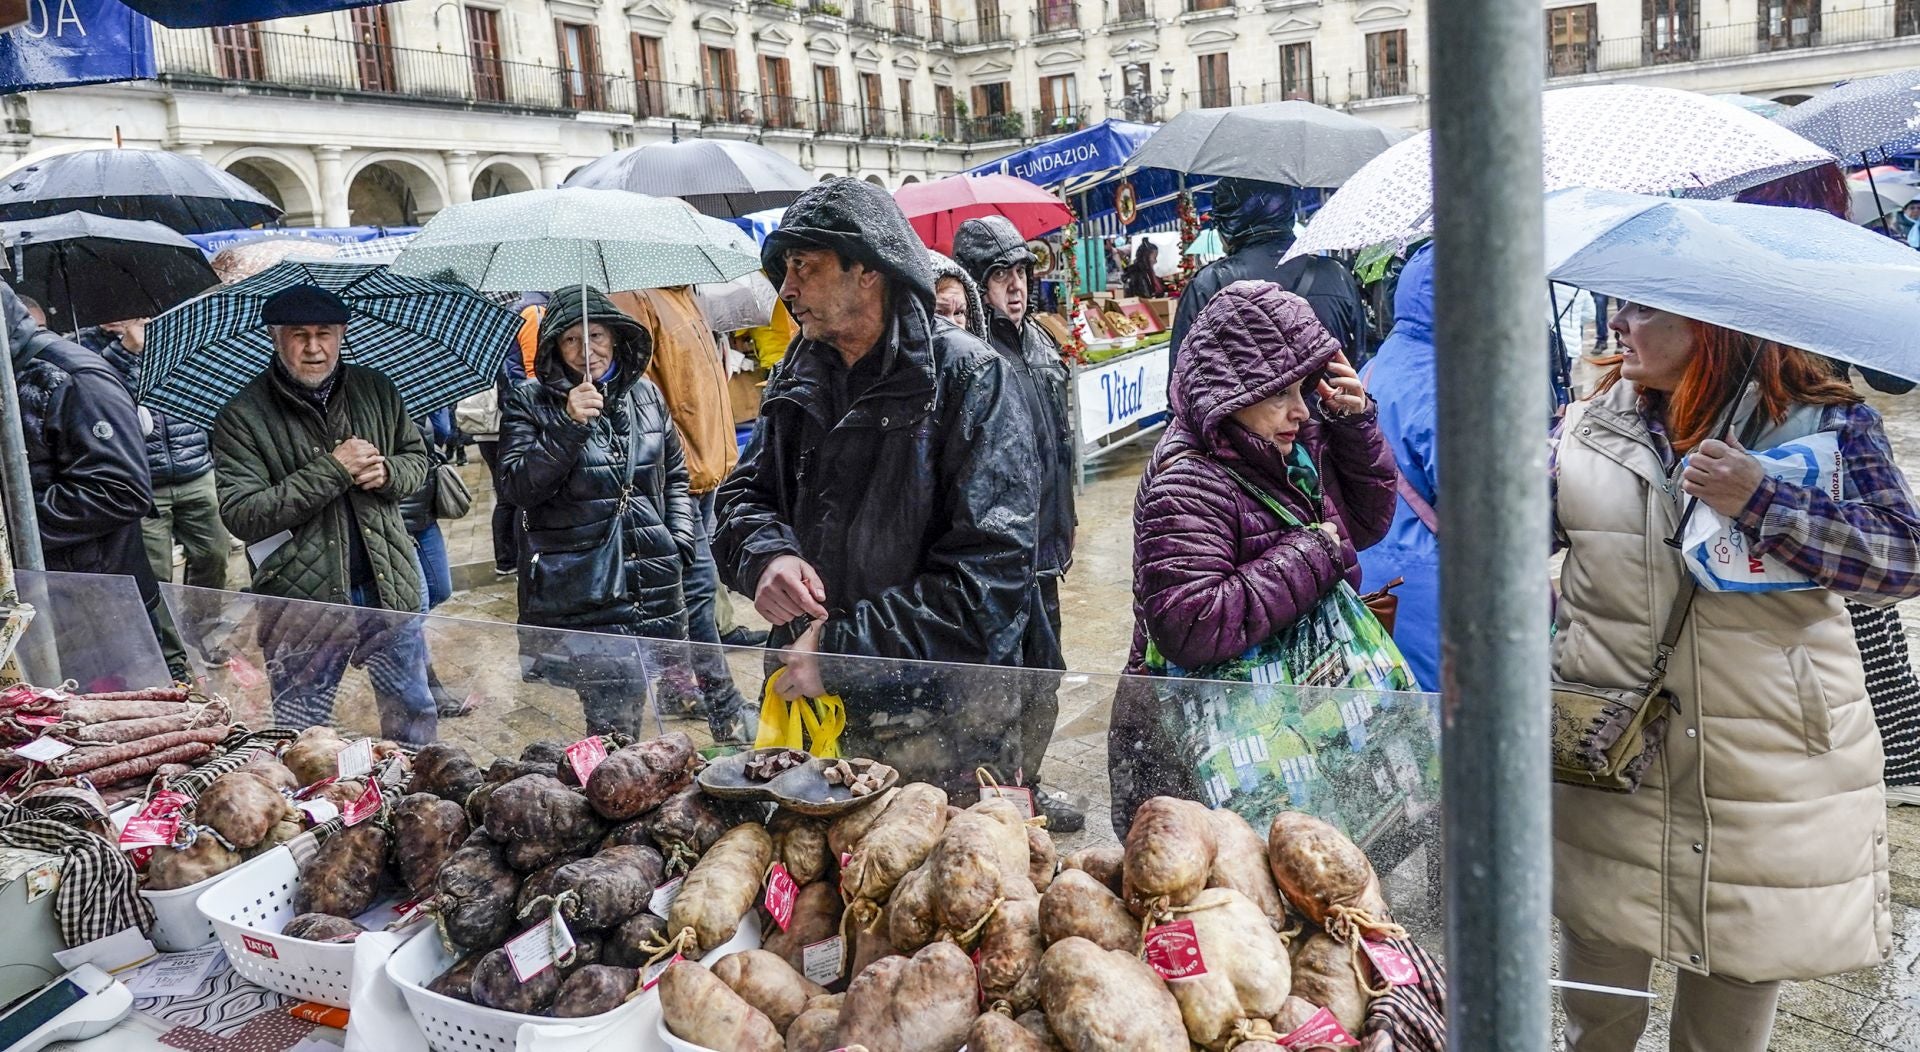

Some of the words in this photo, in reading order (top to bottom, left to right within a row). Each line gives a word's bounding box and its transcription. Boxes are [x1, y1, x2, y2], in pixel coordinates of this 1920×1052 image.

[1015, 143, 1100, 180] FUNDAZIOA
[1101, 366, 1143, 424] Vital
[244, 938, 274, 955] TATAY
[171, 959, 196, 967] 2024
